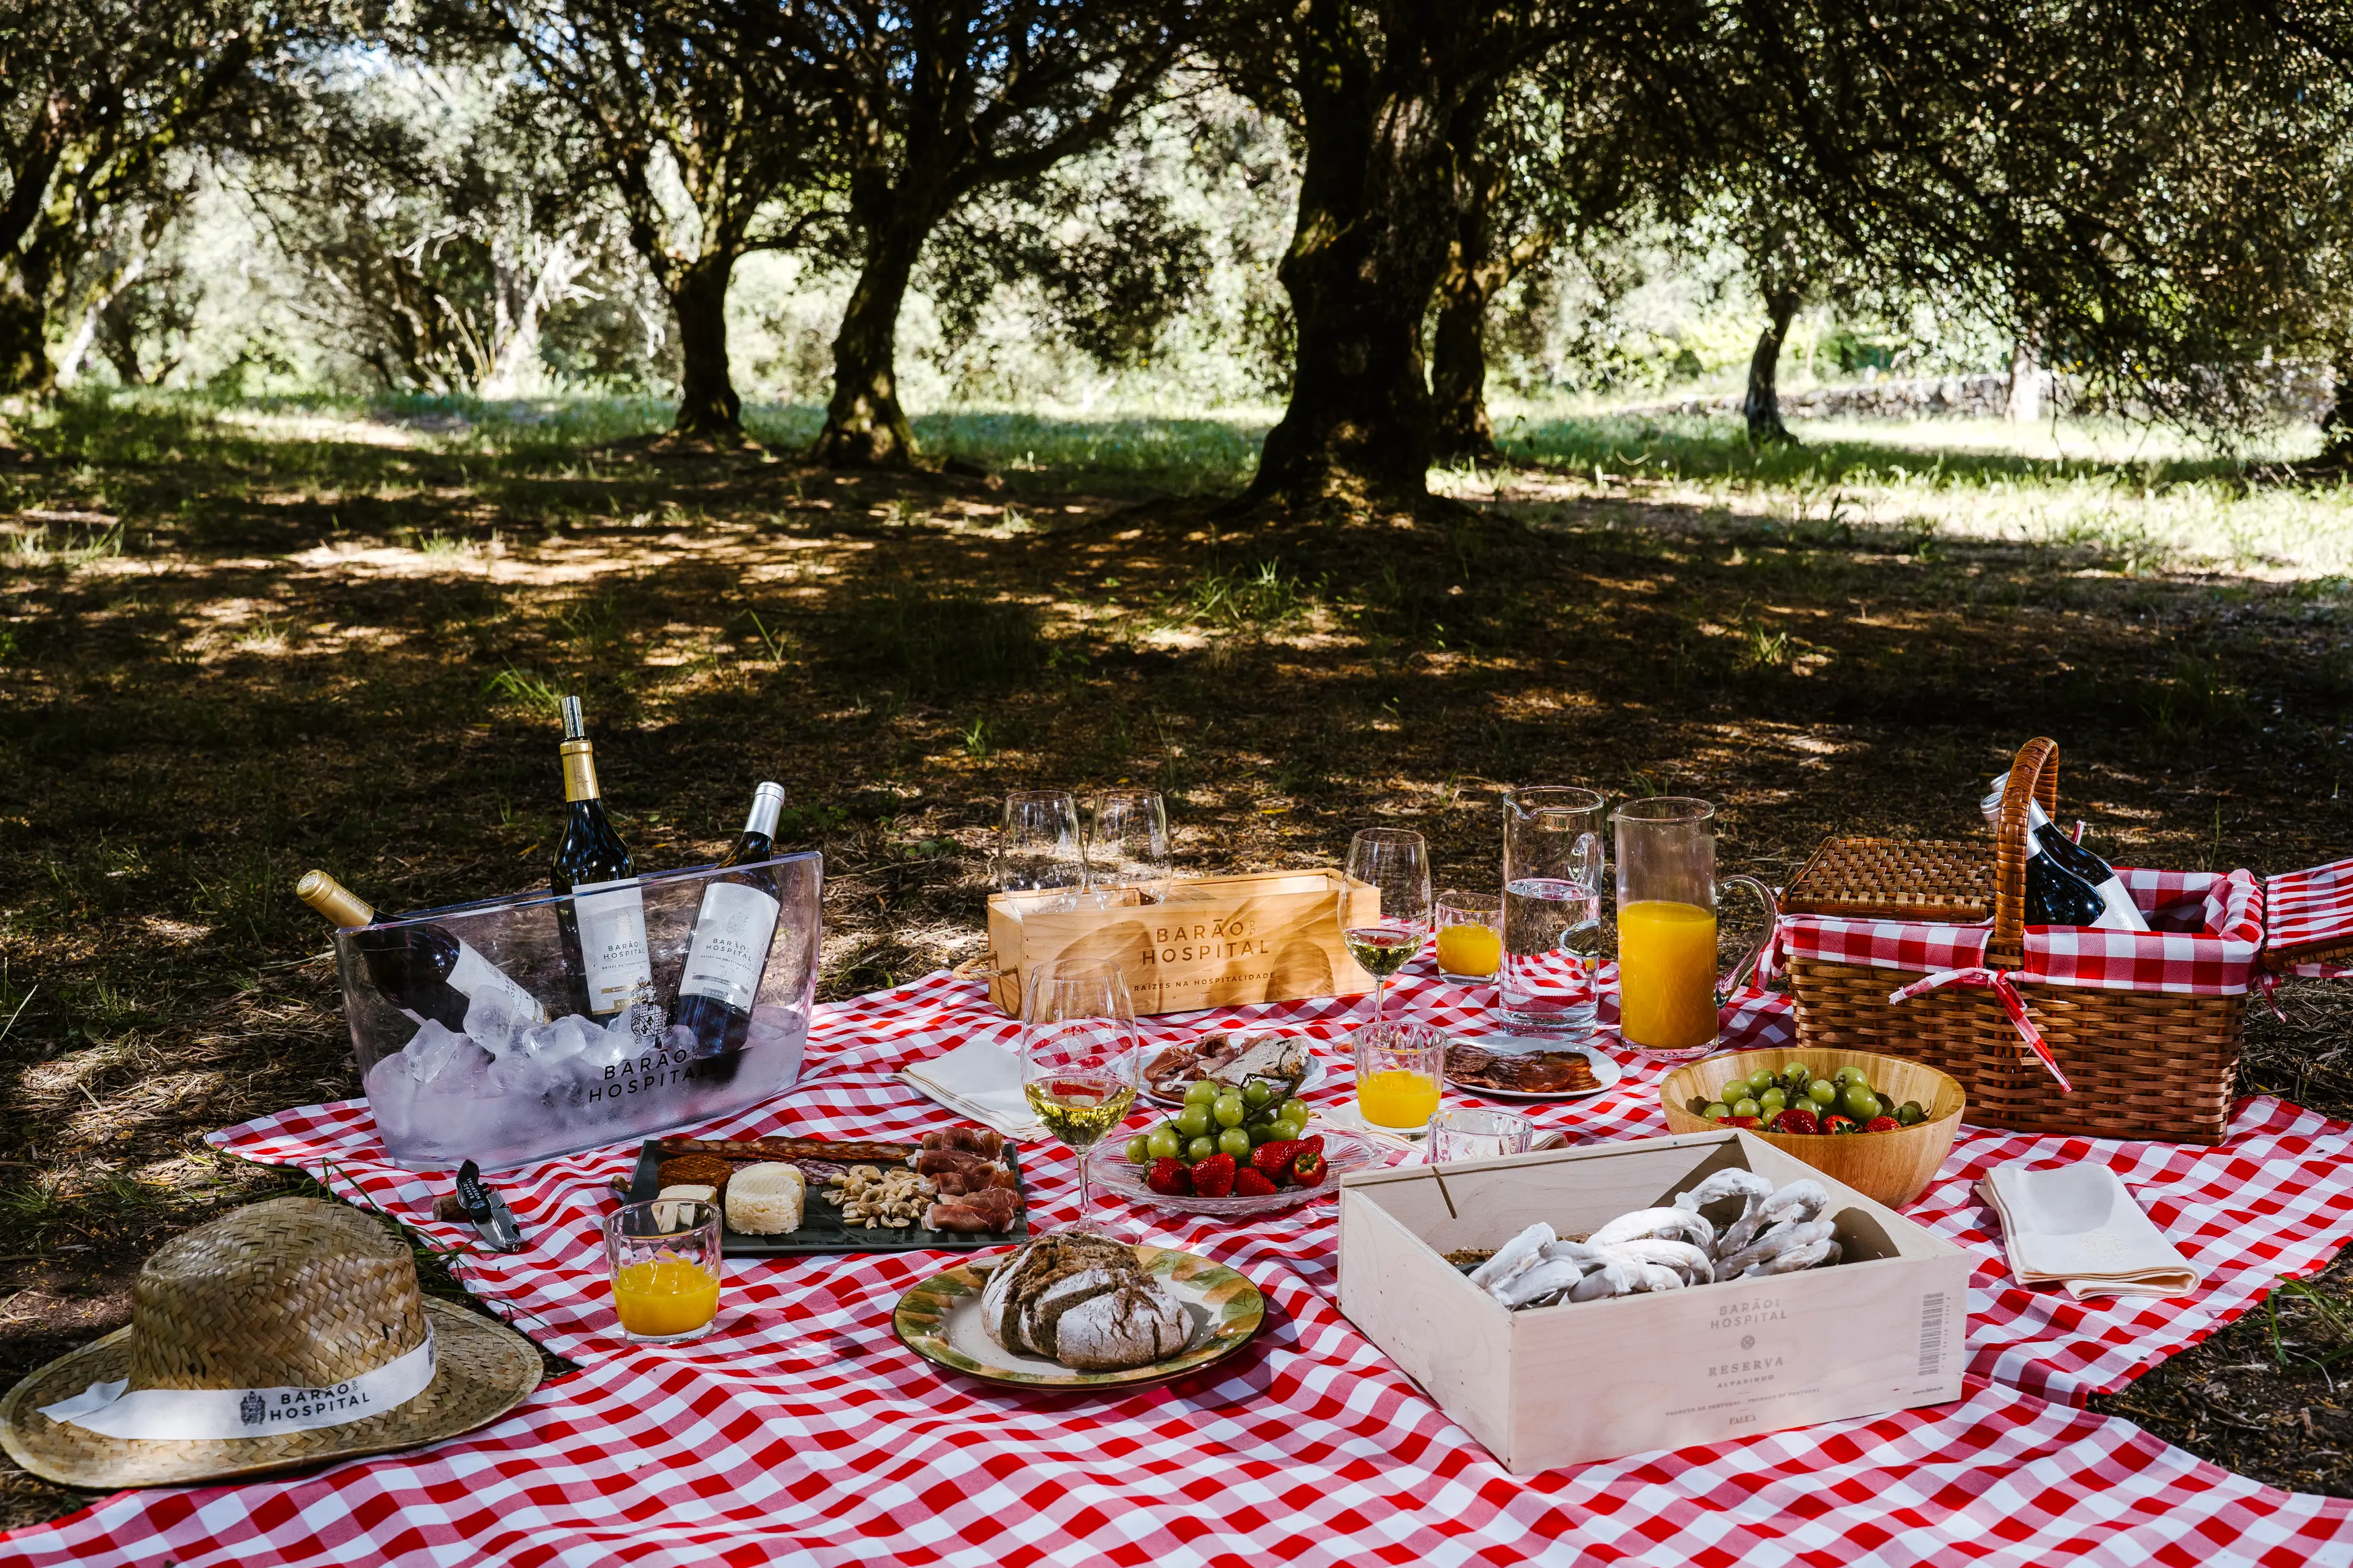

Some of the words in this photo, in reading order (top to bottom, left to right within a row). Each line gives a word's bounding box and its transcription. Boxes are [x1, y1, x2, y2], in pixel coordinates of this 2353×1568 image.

[1156, 919, 1244, 943] BARÃO
[608, 940, 639, 952] BARÃO
[706, 944, 752, 962] HOSPITAL
[713, 938, 746, 950] BARÃO
[1142, 940, 1269, 965] HOSPITAL
[603, 948, 645, 960] HOSPITAL
[1133, 983, 1170, 992] RAÍZES
[1175, 980, 1189, 988] NA
[1194, 972, 1276, 986] HOSPITALIDADE
[604, 1048, 687, 1081] BARÃO
[467, 1178, 481, 1199] HOSPITAL
[1720, 1298, 1773, 1315] BARÃO
[1710, 1310, 1787, 1329] HOSPITAL
[1708, 1356, 1784, 1377] RESERVA
[1717, 1374, 1774, 1389] ALVARINHO
[281, 1383, 348, 1405] BARÃO
[270, 1392, 370, 1421] HOSPITAL
[1728, 1414, 1757, 1426] FALUA
